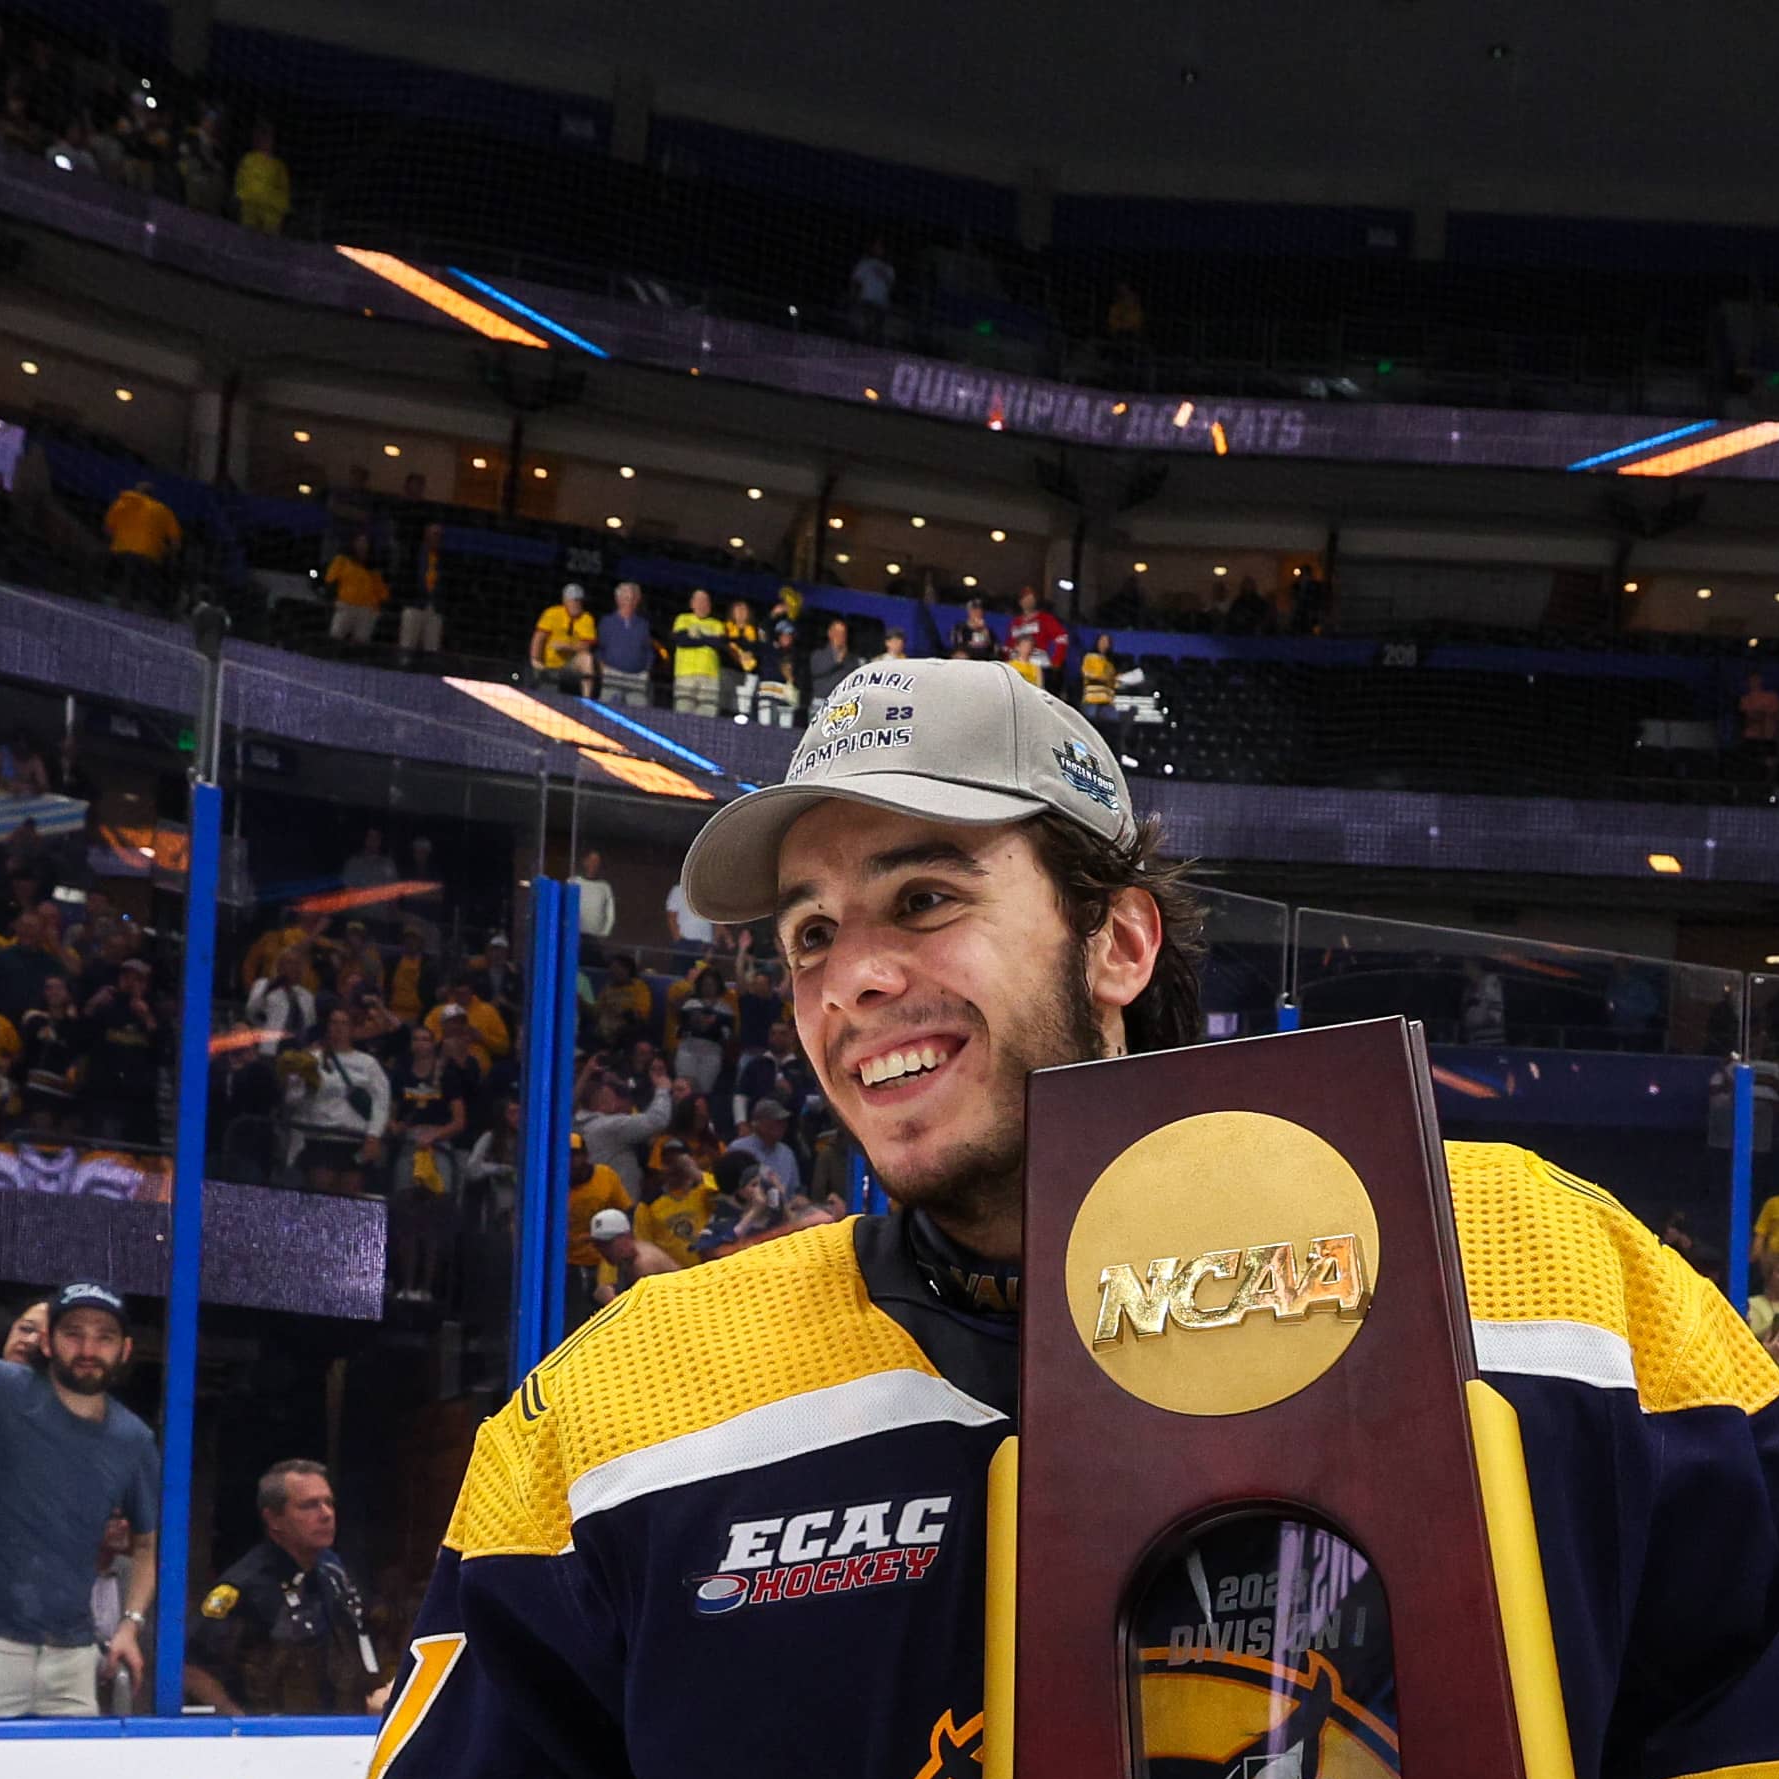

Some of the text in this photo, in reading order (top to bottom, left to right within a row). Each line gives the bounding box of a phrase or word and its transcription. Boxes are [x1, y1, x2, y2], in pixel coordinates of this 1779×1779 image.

[885, 706, 914, 721] 23
[1093, 1232, 1371, 1351] NCAA
[718, 1496, 952, 1573] ECAC
[748, 1546, 940, 1604] HOCKEY
